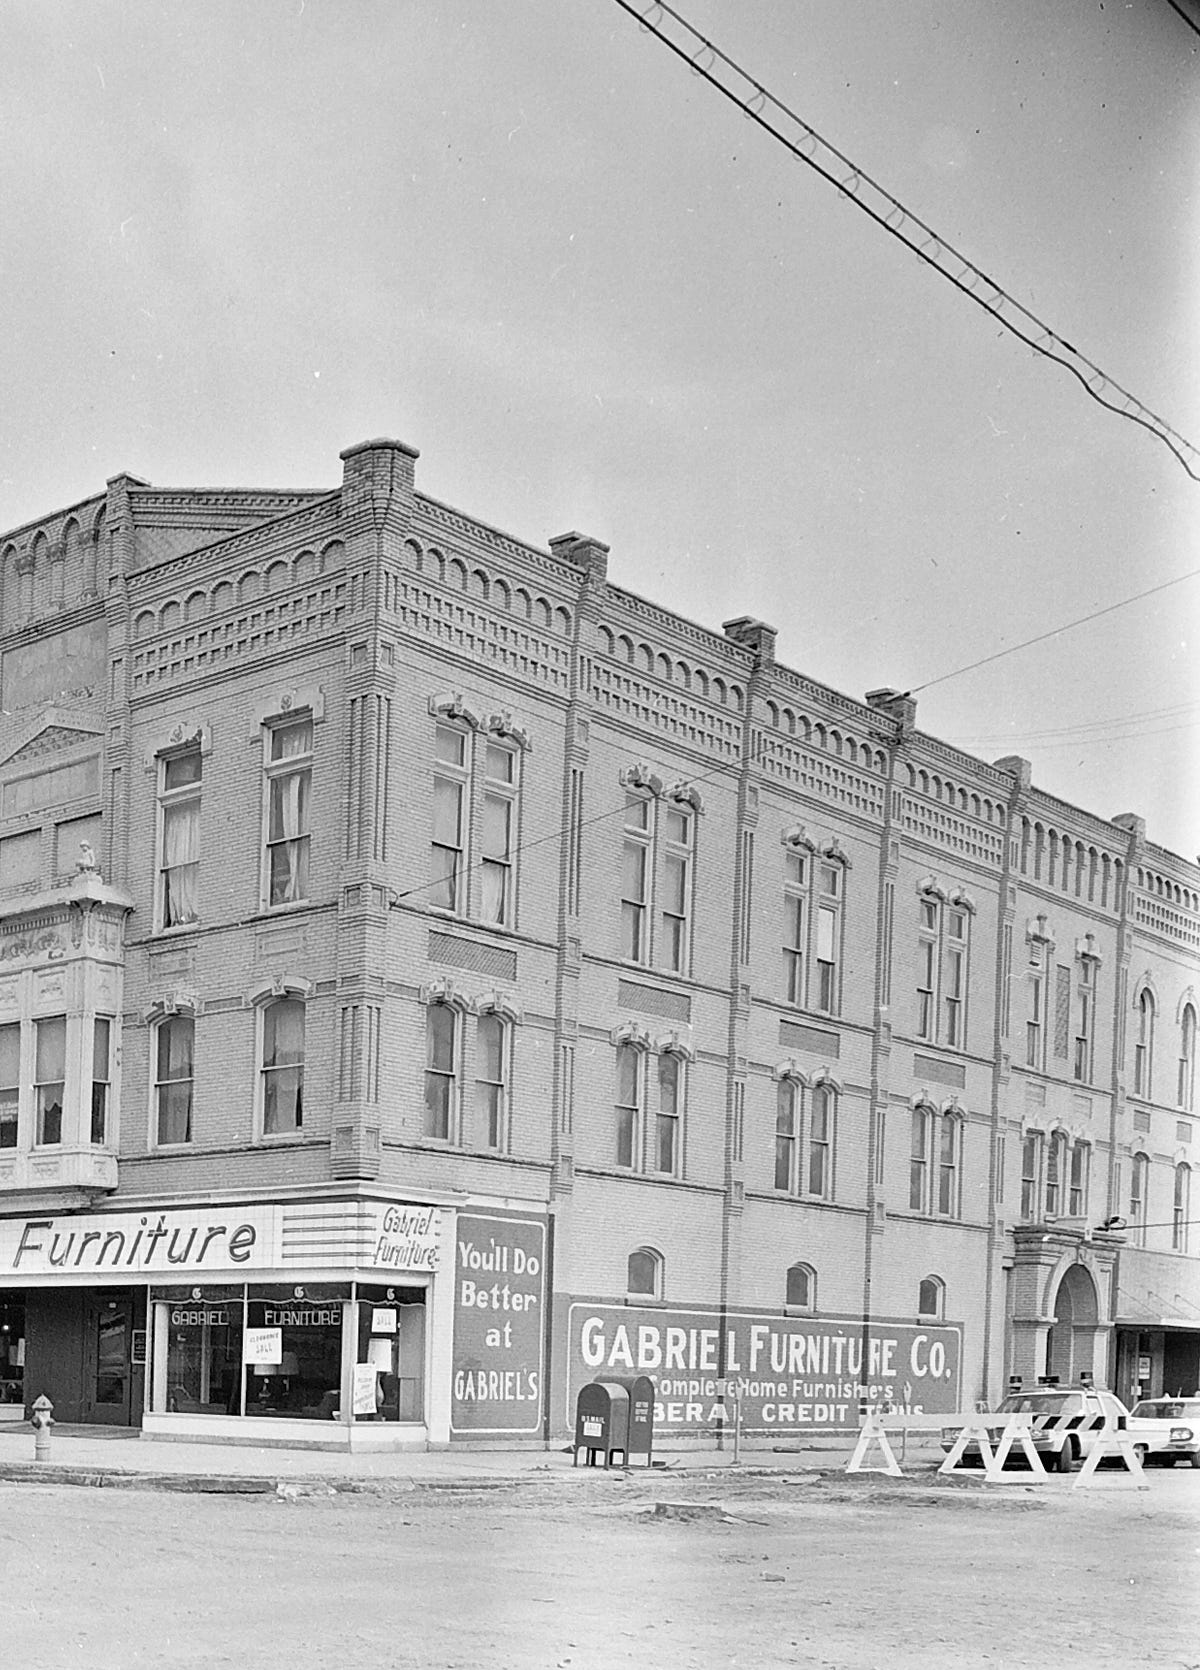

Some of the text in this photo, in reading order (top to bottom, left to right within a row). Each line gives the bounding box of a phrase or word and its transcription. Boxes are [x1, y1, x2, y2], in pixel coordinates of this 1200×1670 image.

[383, 1206, 434, 1237] Gabriel
[13, 1215, 258, 1269] Furniture
[374, 1236, 437, 1269] Furniture
[458, 1238, 540, 1275] You'll Do
[460, 1280, 537, 1312] Better
[171, 1310, 341, 1326] GABRIEL FURNITURE
[485, 1320, 513, 1348] at
[581, 1316, 741, 1372] GABRIEL
[749, 1325, 898, 1376] FURNITURE
[454, 1368, 539, 1401] GABRIEL'S
[742, 1378, 788, 1398] Home
[653, 1402, 743, 1423] BERAL
[762, 1403, 849, 1423] CREDIT
